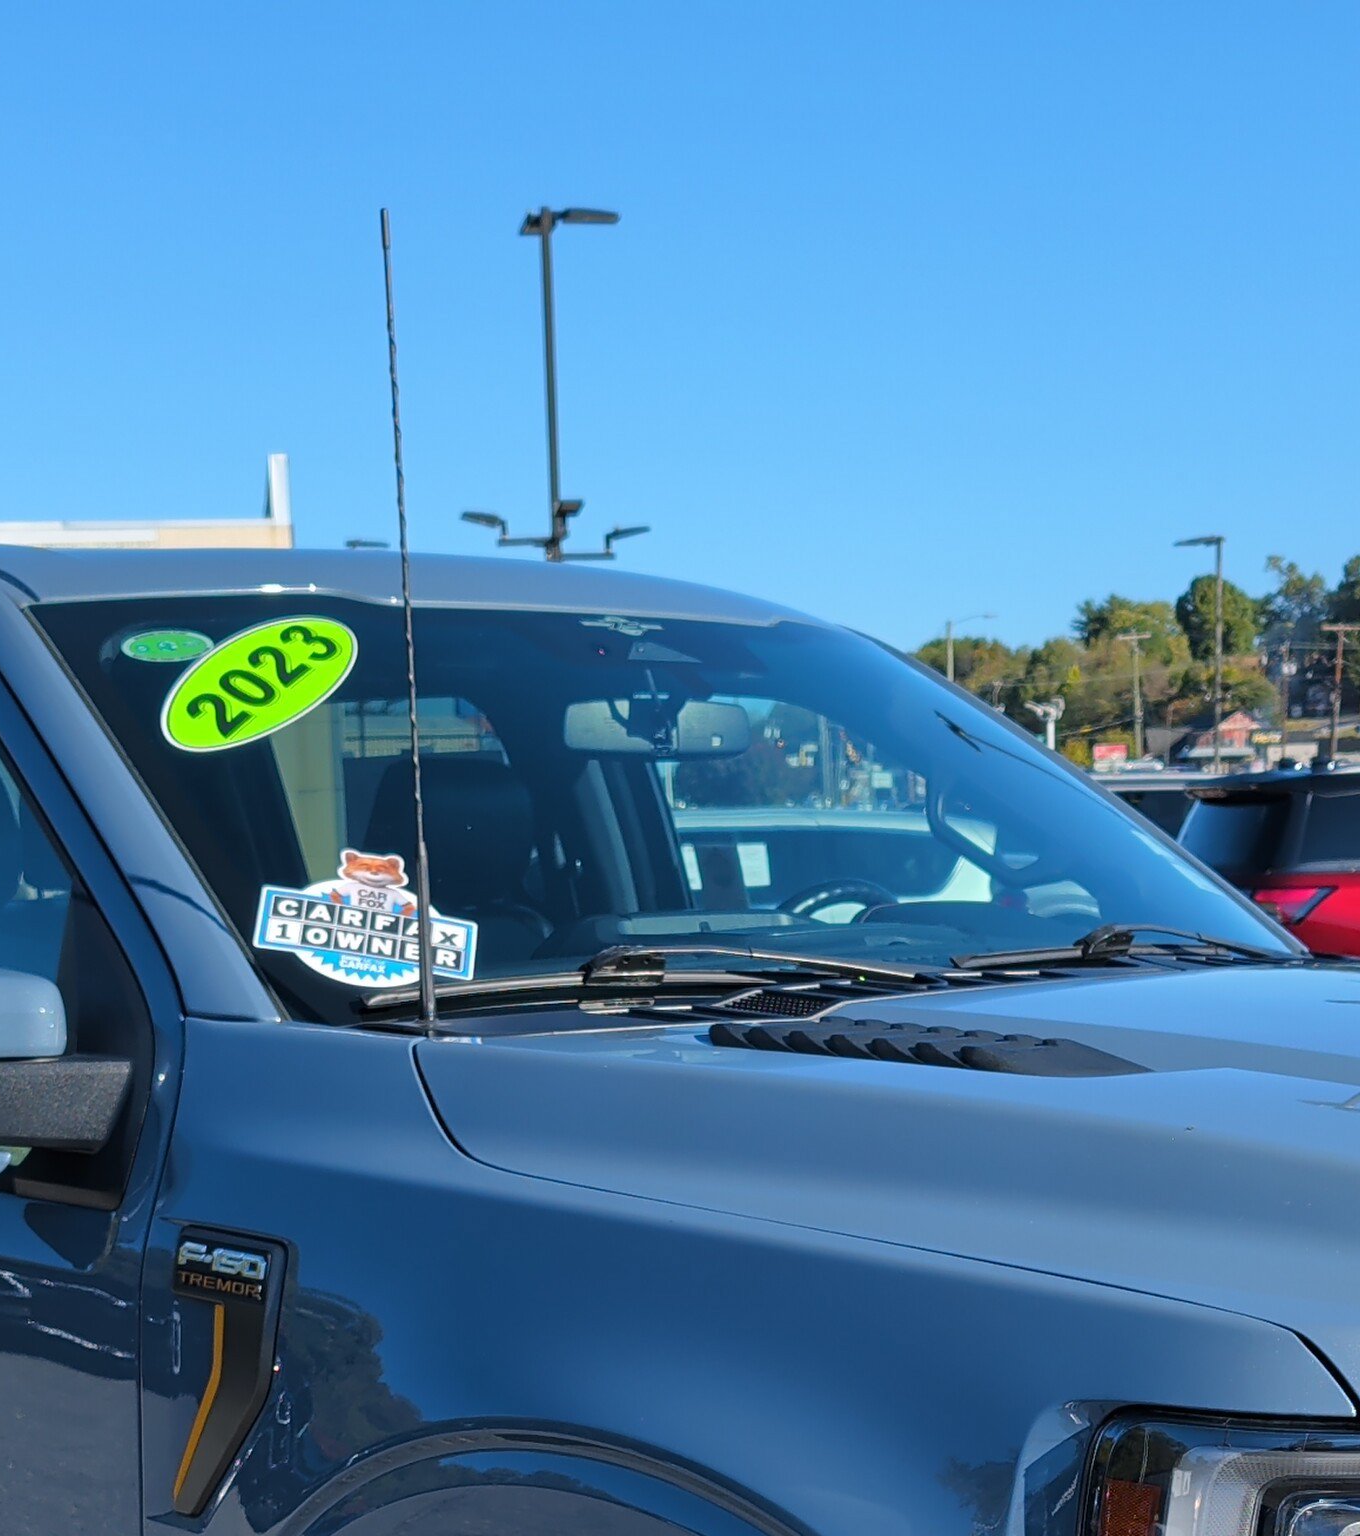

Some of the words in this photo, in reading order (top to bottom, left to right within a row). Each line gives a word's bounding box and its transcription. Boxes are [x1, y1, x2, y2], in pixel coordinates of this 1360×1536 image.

[186, 625, 341, 740] 2023
[357, 888, 388, 902] CAR
[357, 898, 386, 910] FOX
[277, 898, 459, 947] CARFAX
[339, 959, 387, 975] CARFAX
[177, 1271, 262, 1301] TREMOR
